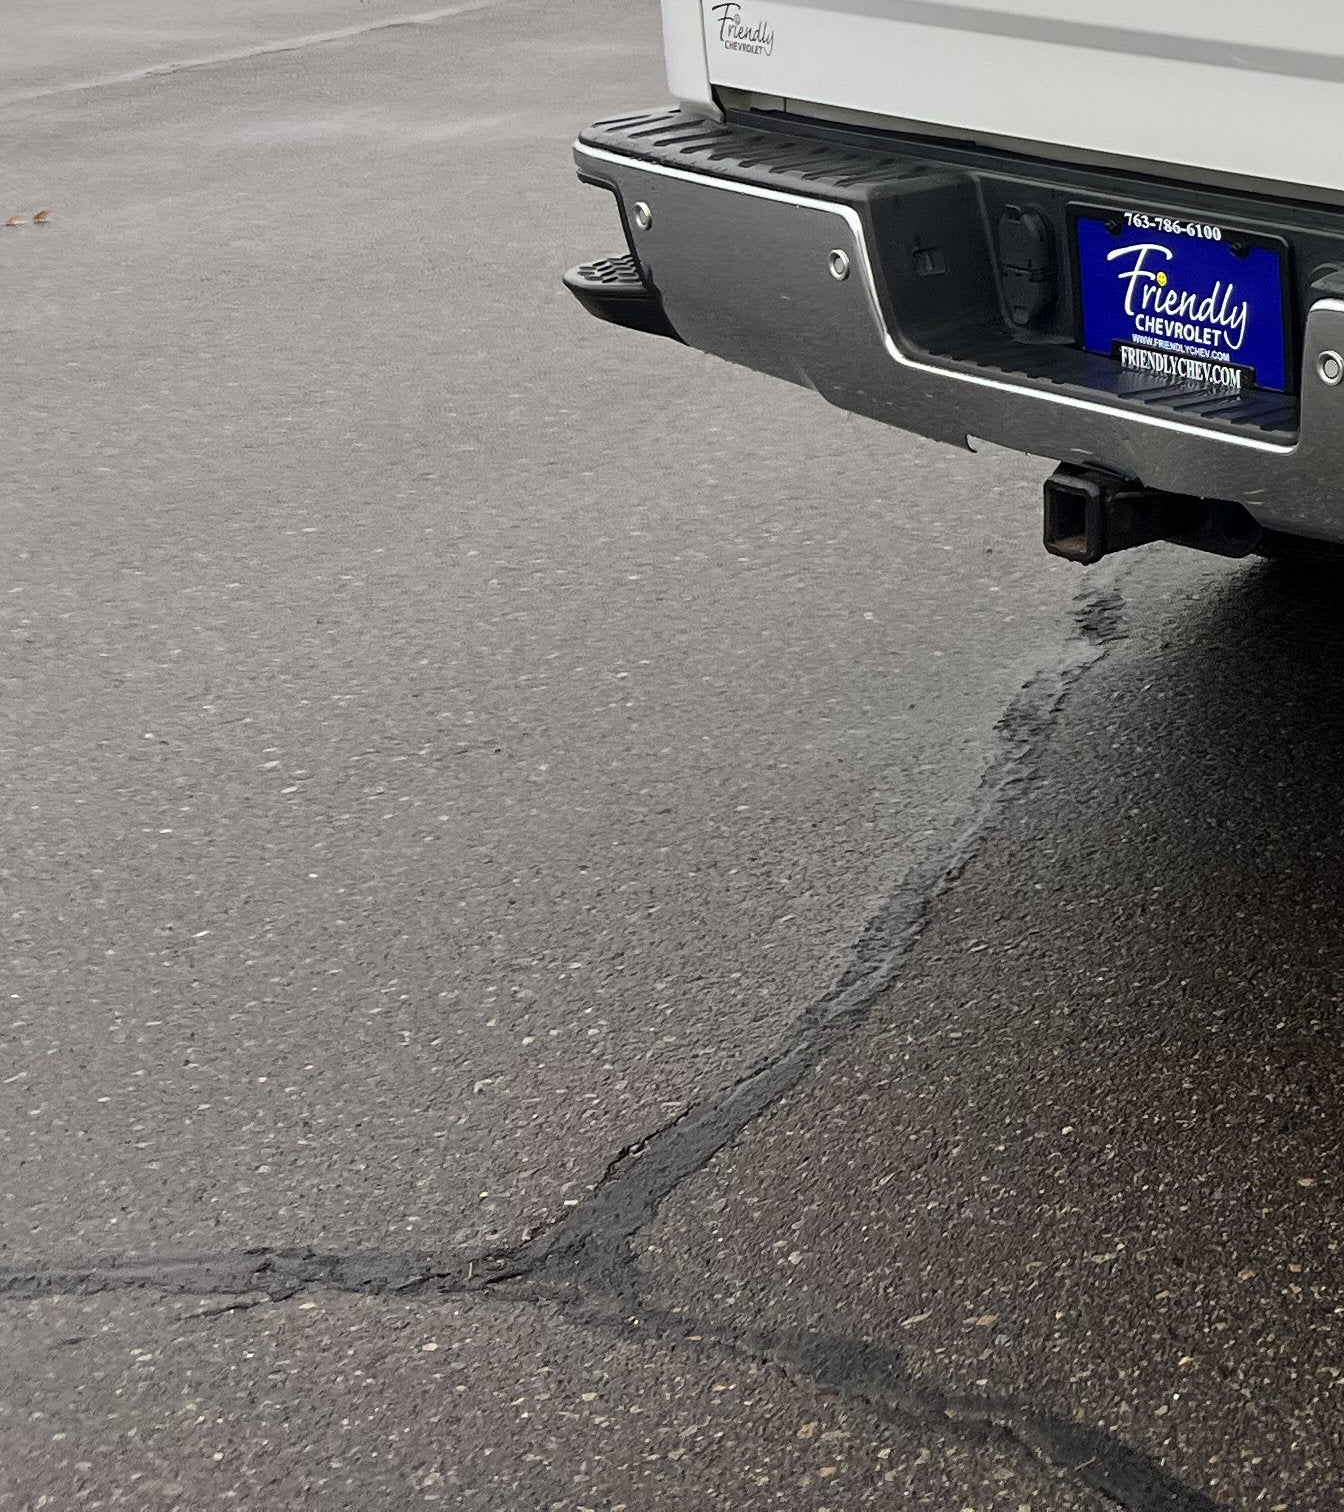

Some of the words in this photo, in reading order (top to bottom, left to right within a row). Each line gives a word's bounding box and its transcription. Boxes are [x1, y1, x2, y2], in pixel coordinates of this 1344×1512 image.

[711, 2, 775, 57] Friendly
[724, 39, 764, 55] CHEVROLET
[1123, 212, 1222, 241] 763-786-6100
[1106, 243, 1248, 350] Friendly
[1134, 313, 1222, 347] CHEVROLET
[1131, 333, 1231, 363] WWW.FRIENDLYCHEV.COM
[1120, 345, 1242, 389] FRIENDLYCHEV.COM
